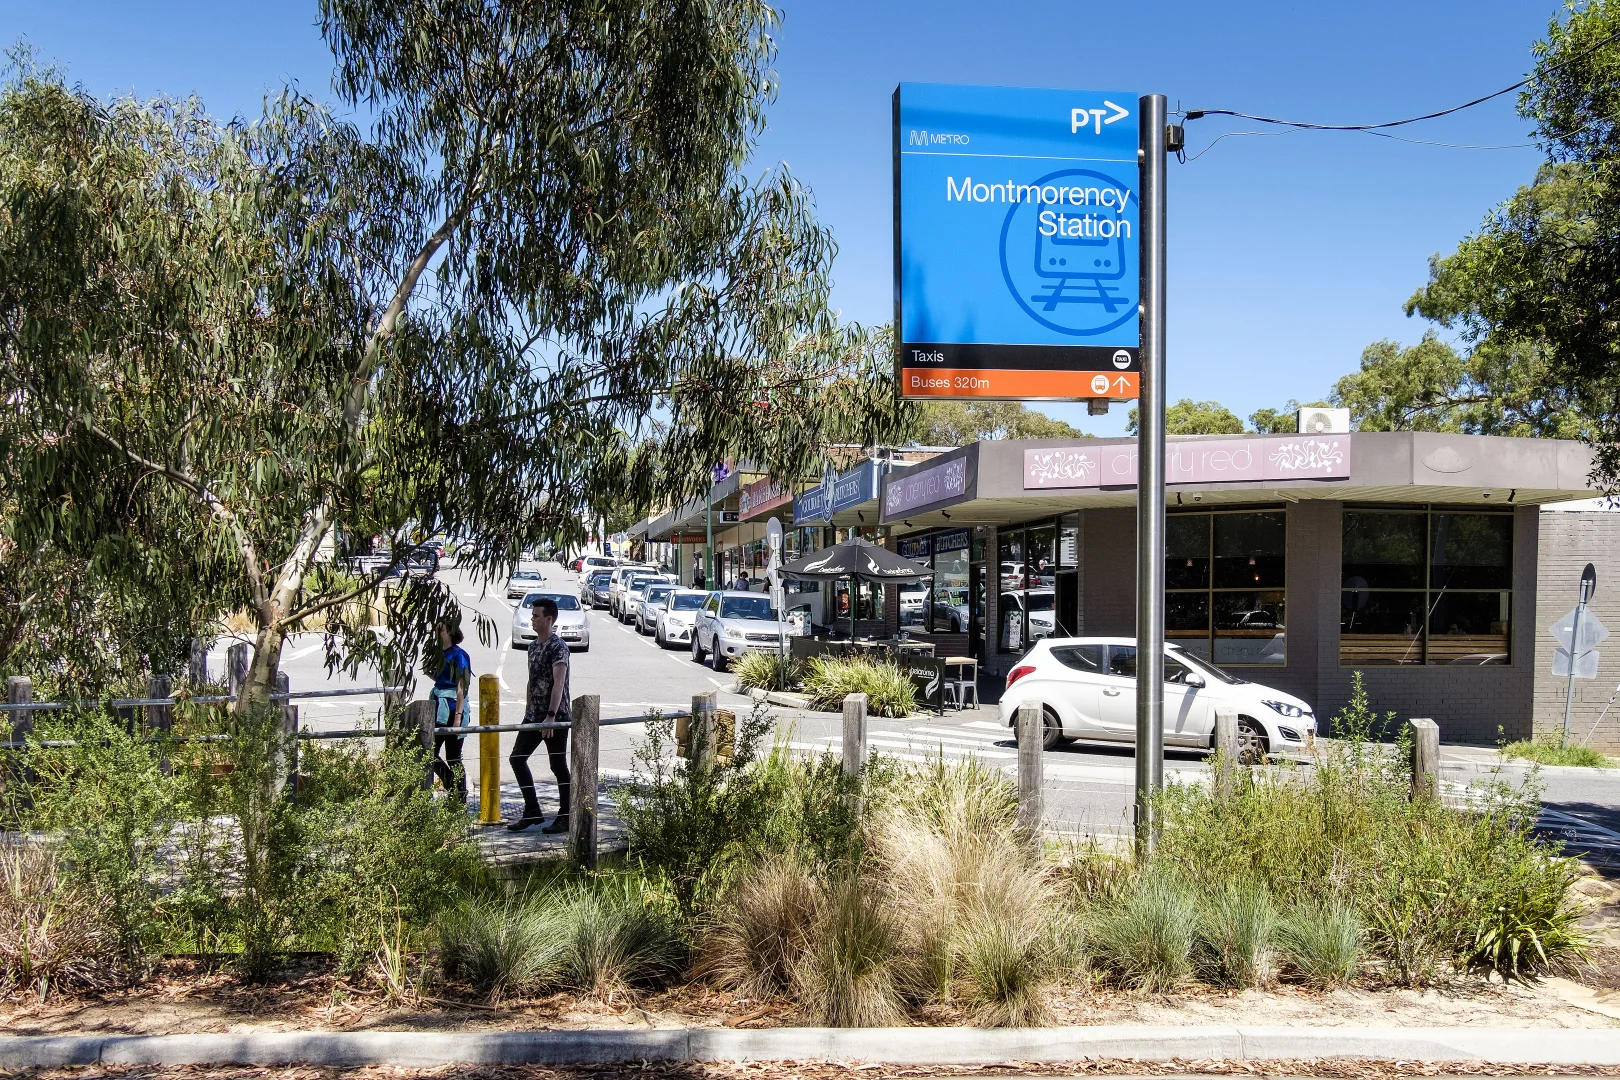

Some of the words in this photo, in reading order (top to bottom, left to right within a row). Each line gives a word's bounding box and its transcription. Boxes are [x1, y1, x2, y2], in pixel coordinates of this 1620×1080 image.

[930, 133, 970, 146] METRO
[946, 176, 1131, 214] Montmorency
[1038, 210, 1131, 239] Station
[911, 349, 944, 363] Taxis
[911, 375, 951, 389] Buses
[954, 376, 990, 389] 320m
[1111, 449, 1194, 478] chry
[1202, 443, 1252, 471] red
[936, 531, 968, 552] BUTCHERS
